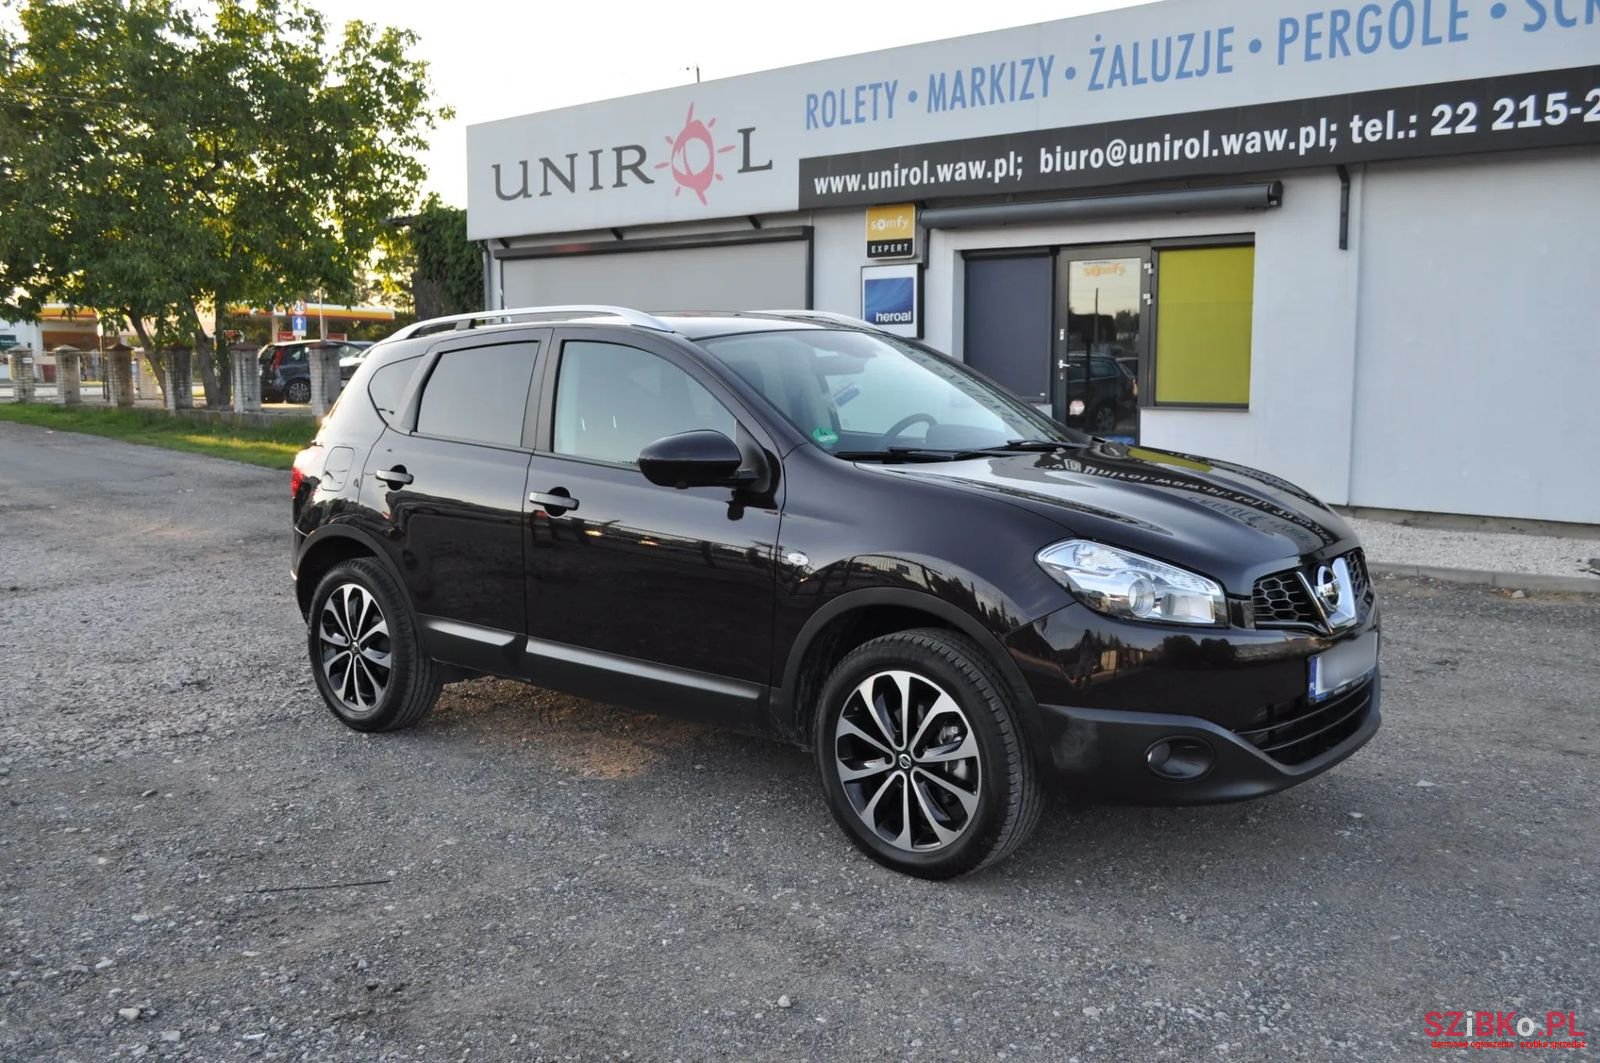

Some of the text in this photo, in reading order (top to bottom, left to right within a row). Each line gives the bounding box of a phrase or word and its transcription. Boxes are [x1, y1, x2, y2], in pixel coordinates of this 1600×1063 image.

[805, 79, 899, 131] ROLETY
[926, 54, 1055, 113] MARKIZY
[1087, 26, 1235, 92] ŻALUZJE
[1277, 0, 1470, 66] PERGOLE
[491, 106, 774, 205] UNIROL
[813, 87, 1600, 196] www.unirol.waw.pl; biuro@unirol.waw.pl; tel.: 22 215-2
[870, 215, 909, 232] somfy
[871, 243, 909, 254] EXPERT
[875, 310, 912, 323] heroal
